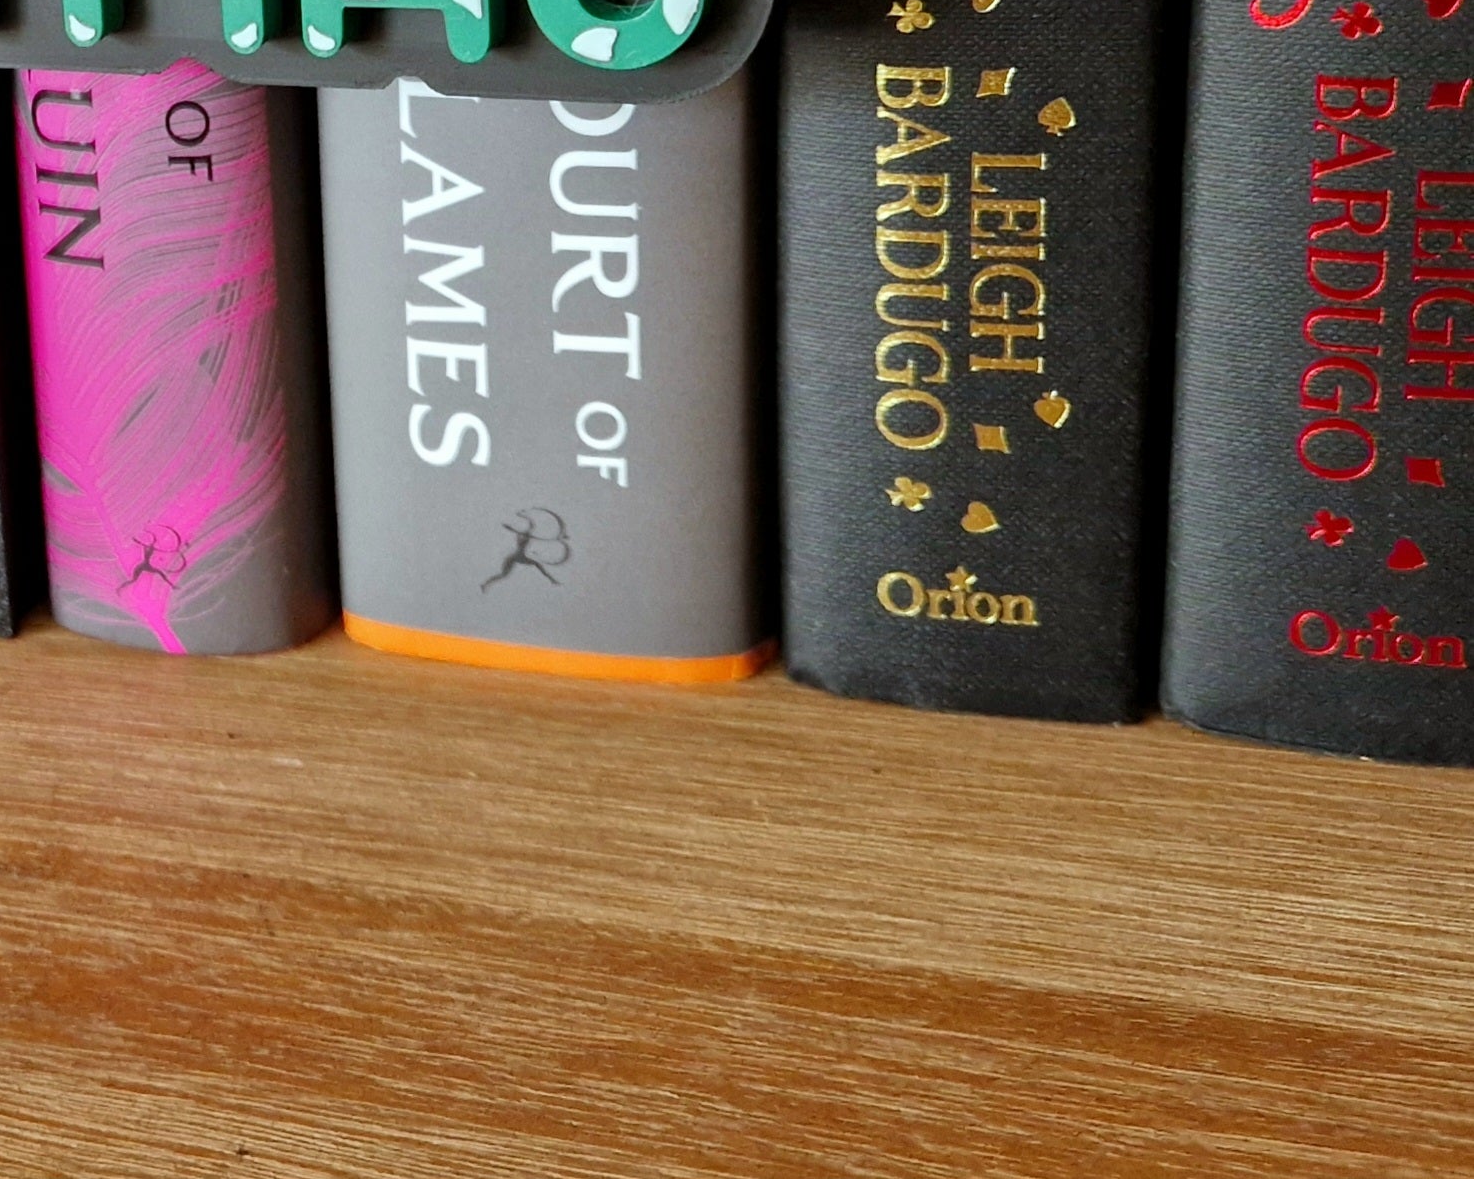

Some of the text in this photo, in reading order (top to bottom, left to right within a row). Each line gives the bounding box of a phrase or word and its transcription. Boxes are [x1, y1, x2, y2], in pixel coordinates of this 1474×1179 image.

[165, 99, 214, 182] OF
[873, 62, 952, 451] BARDUGO
[969, 152, 1048, 373] LEIGH
[1295, 72, 1399, 482] BARDUGO
[574, 400, 628, 488] OF
[875, 564, 1040, 627] Orion
[1287, 604, 1468, 669] Orion
